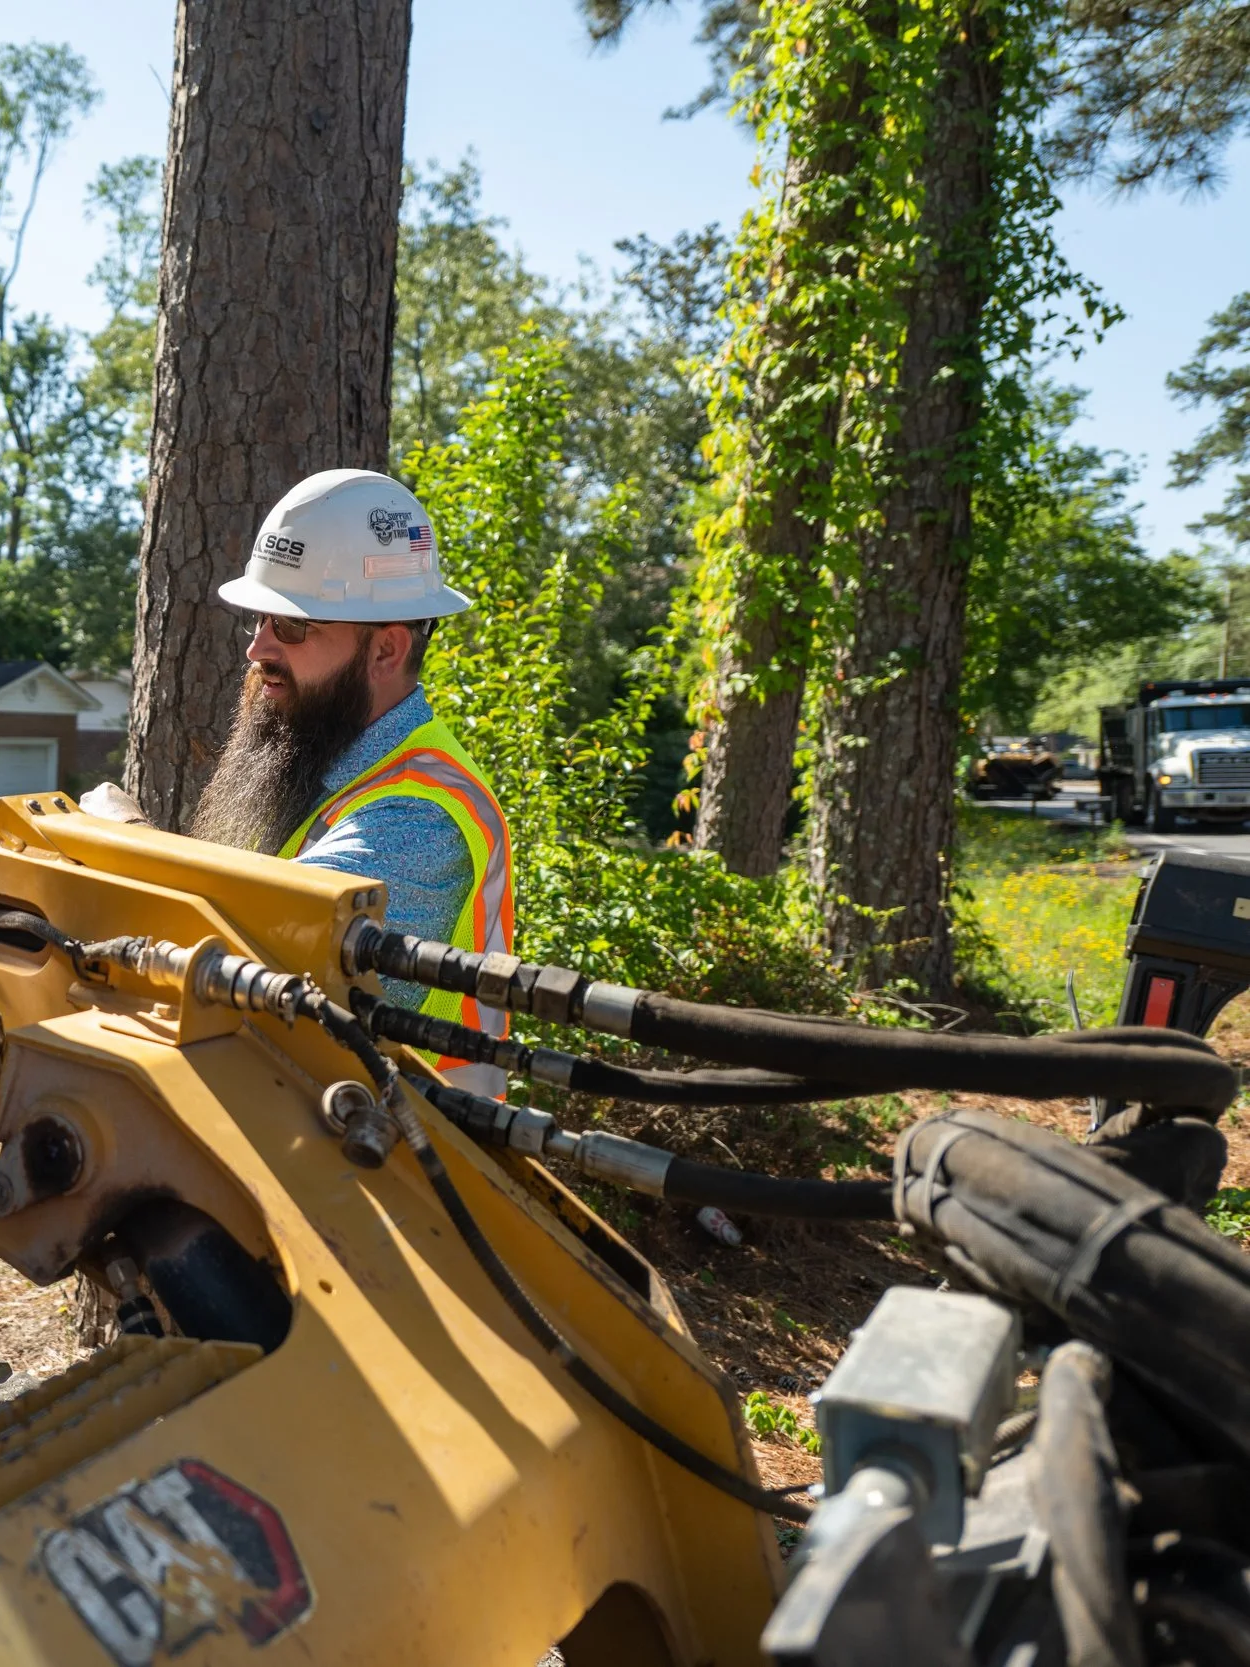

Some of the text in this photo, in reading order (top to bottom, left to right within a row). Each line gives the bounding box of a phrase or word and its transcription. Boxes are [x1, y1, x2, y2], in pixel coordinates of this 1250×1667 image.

[387, 512, 412, 520] SUPPORT
[395, 520, 408, 529] THE
[265, 535, 305, 556] SCS
[44, 1468, 247, 1667] CAT
